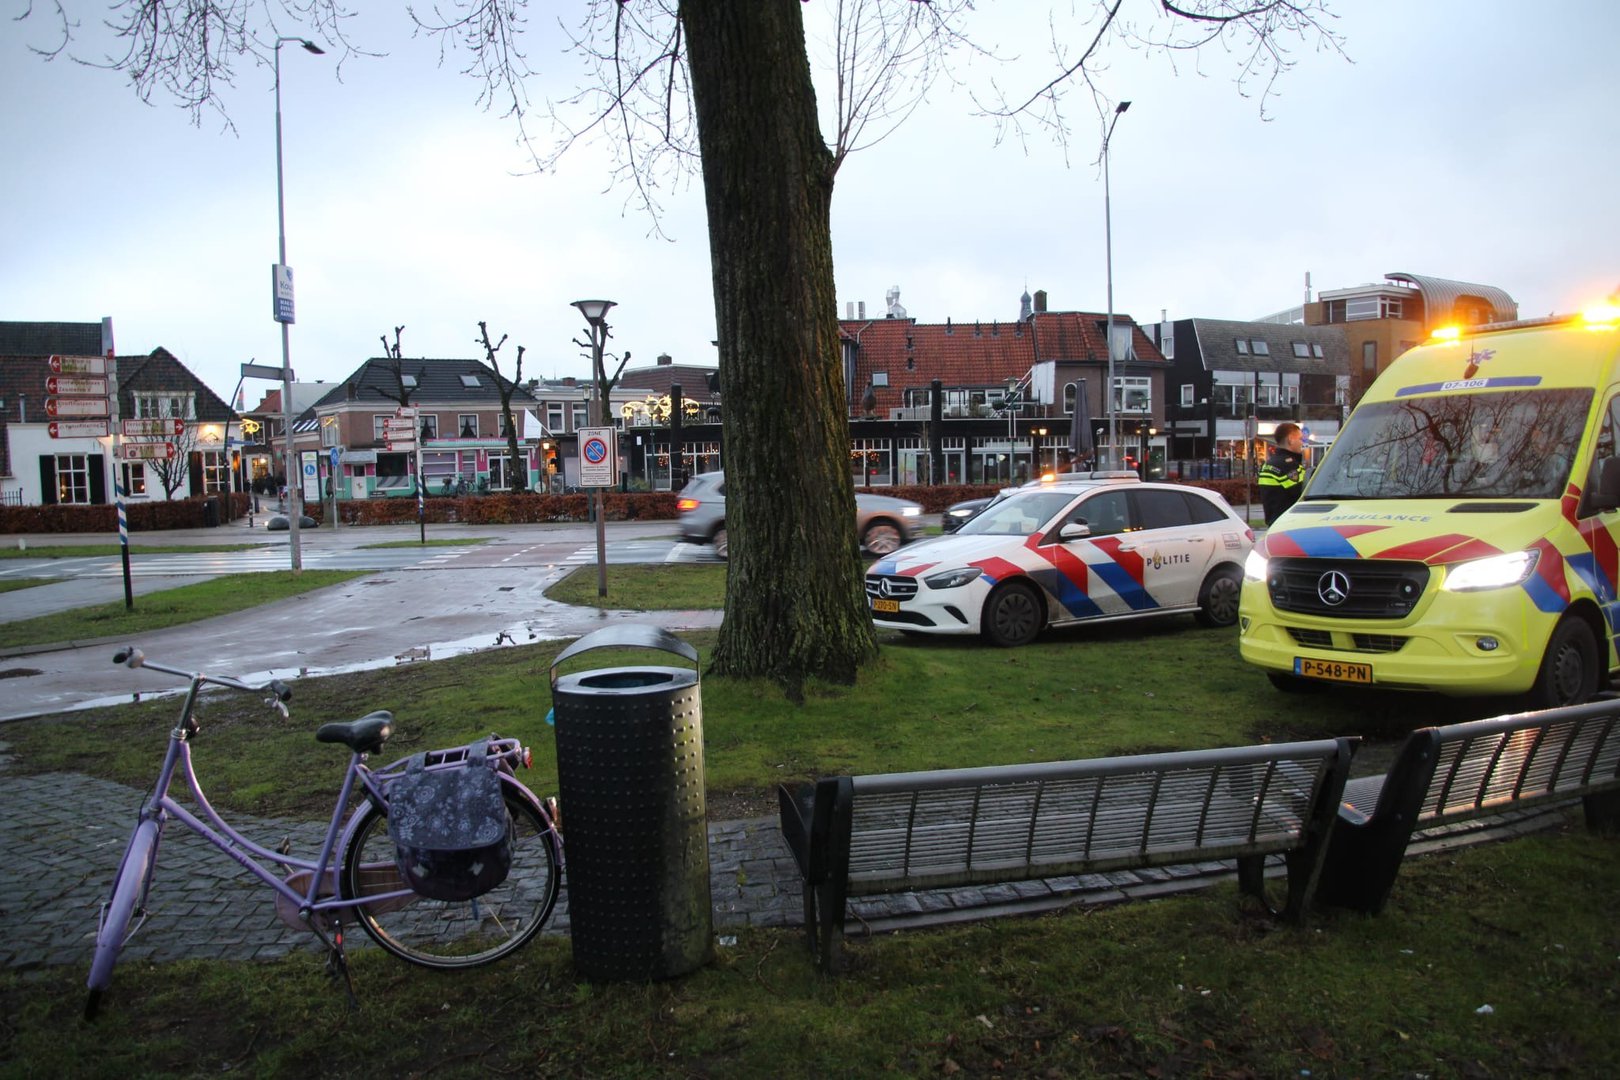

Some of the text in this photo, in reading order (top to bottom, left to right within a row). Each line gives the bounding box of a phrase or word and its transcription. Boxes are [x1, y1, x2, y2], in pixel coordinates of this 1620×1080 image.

[1445, 380, 1484, 390] 07-106
[1319, 513, 1432, 523] AMBULANCE
[1146, 553, 1190, 570] POLITIE
[1303, 661, 1367, 680] P-548-PN
